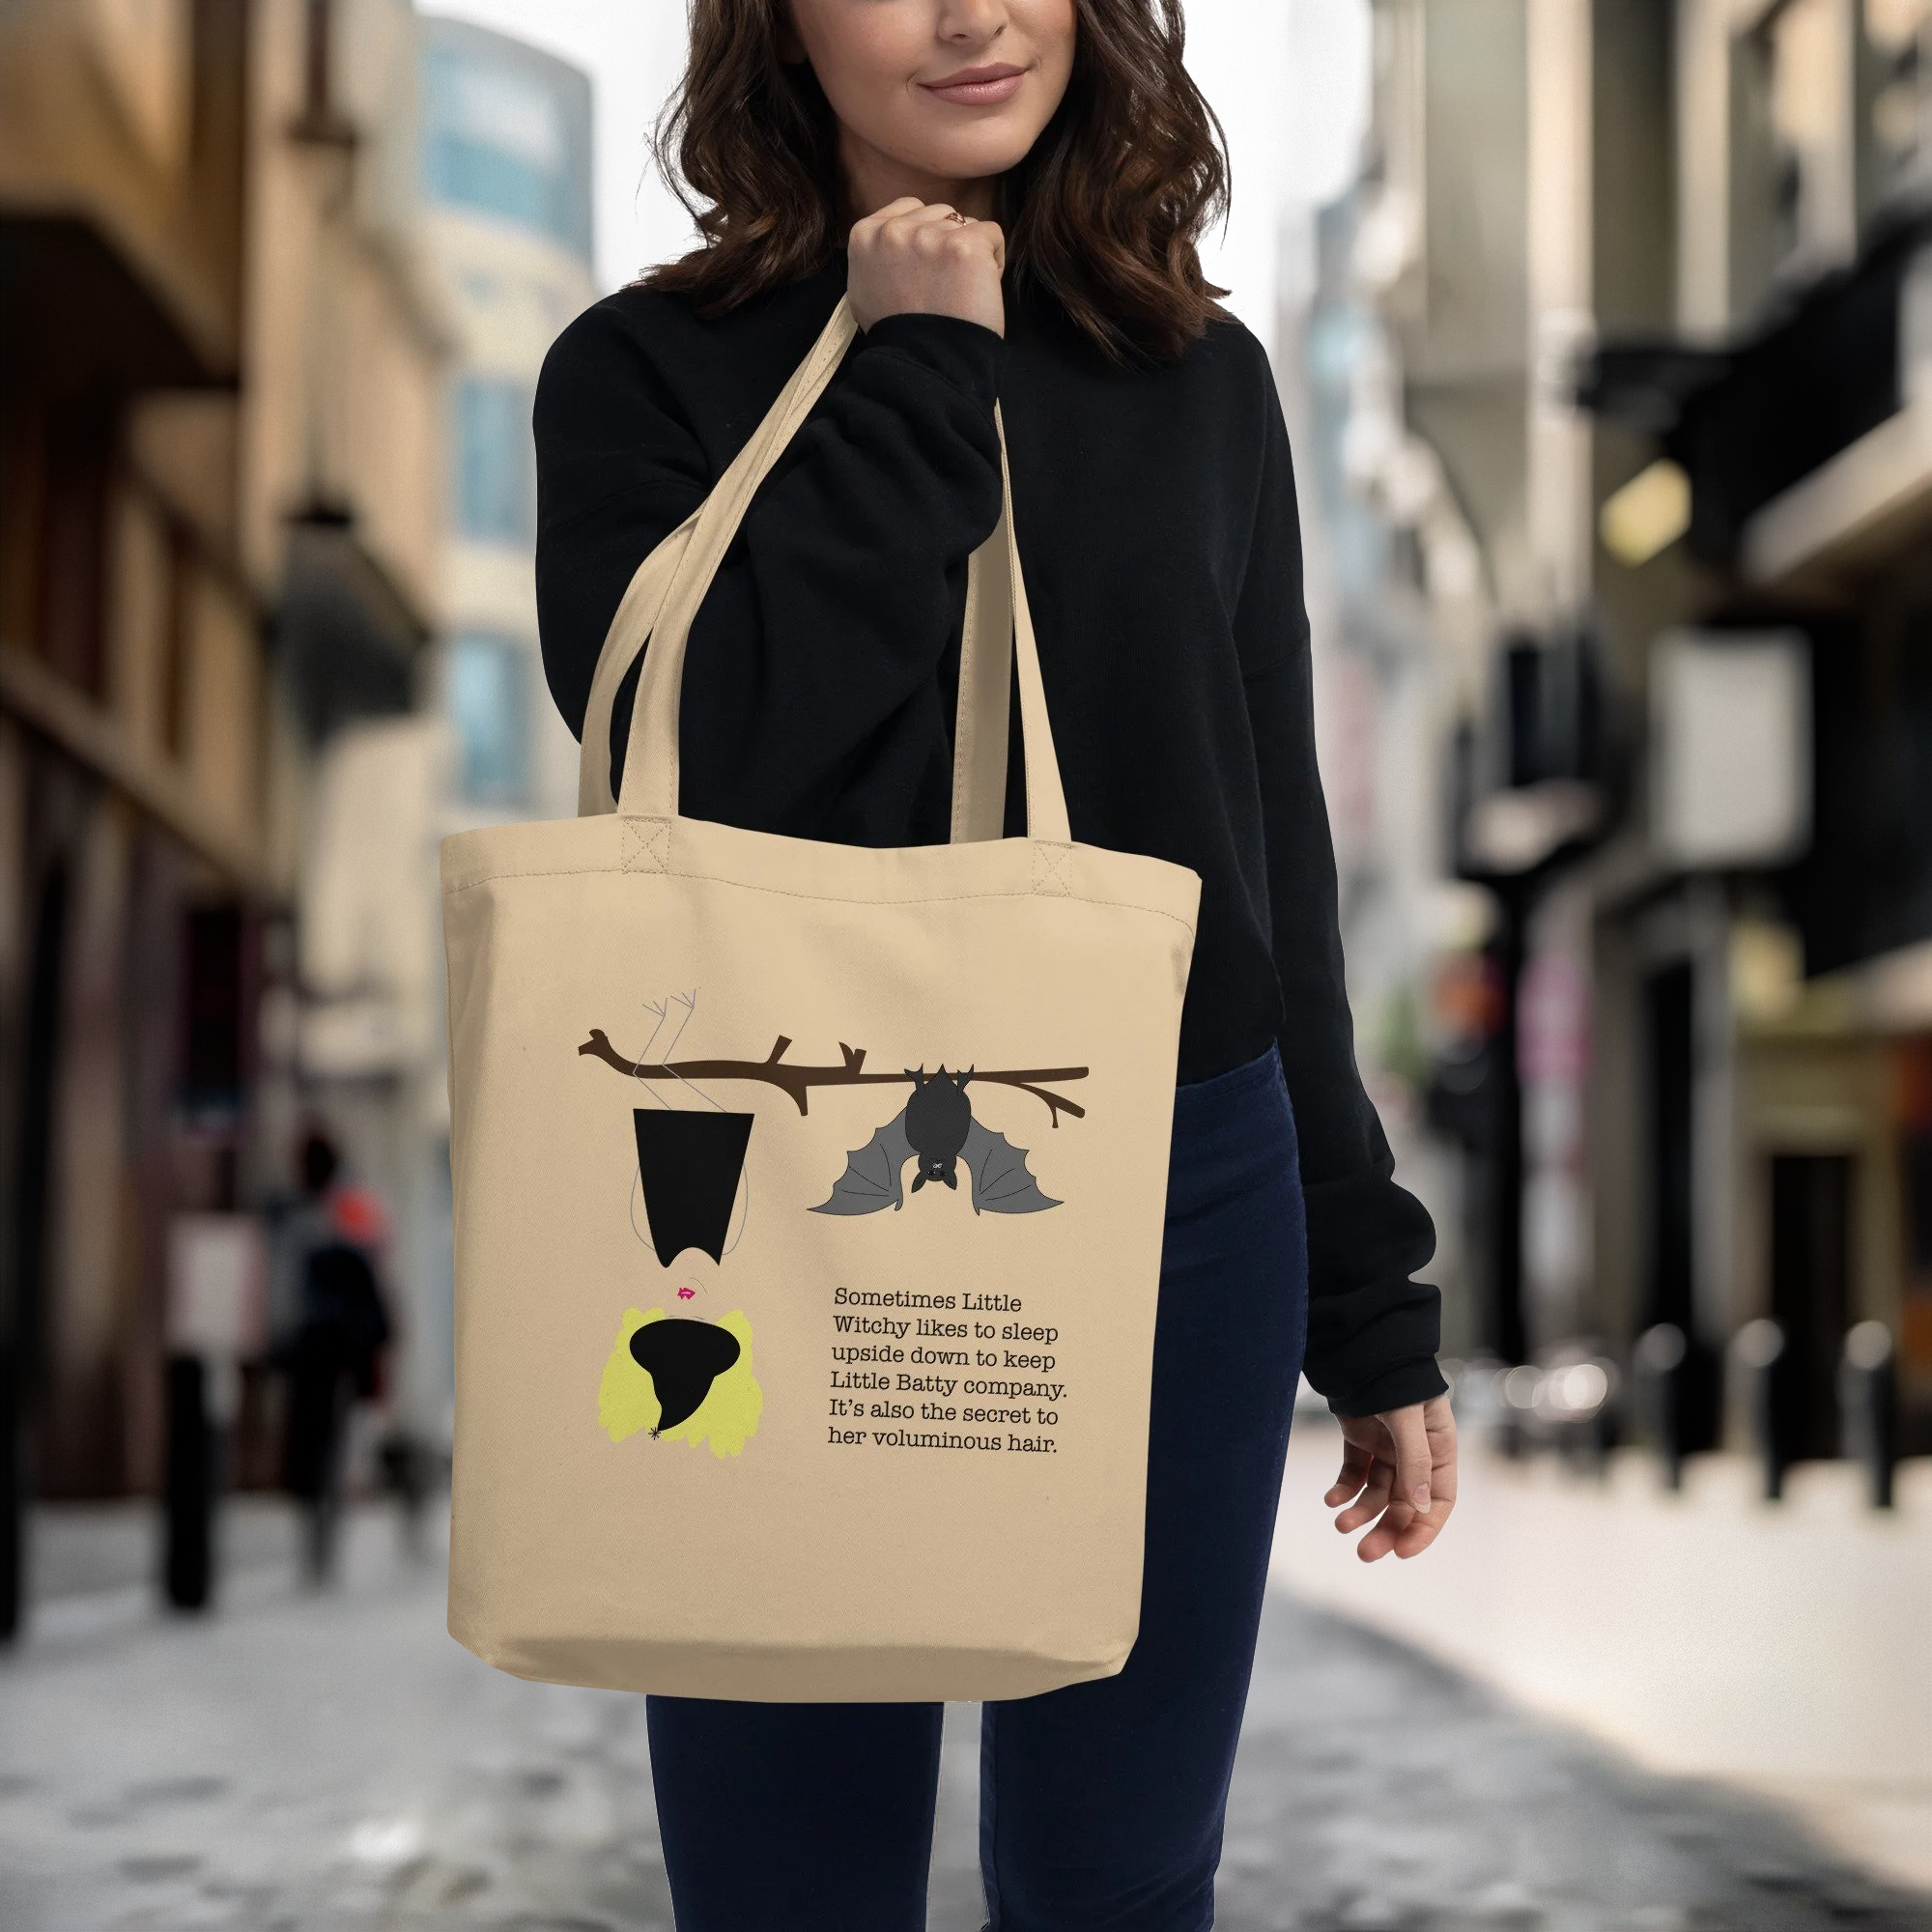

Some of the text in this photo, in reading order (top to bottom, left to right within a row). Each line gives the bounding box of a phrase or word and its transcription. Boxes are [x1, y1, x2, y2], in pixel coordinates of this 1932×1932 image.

[835, 1288, 1021, 1312] Sometimes Little
[833, 1316, 1058, 1345] Witchy likes to sleep
[832, 1346, 1055, 1373] upside down to keep
[830, 1371, 1067, 1402] Little Batty company.
[829, 1399, 1059, 1426] It’s also the secret to
[828, 1427, 1058, 1454] her voluminous hair.
